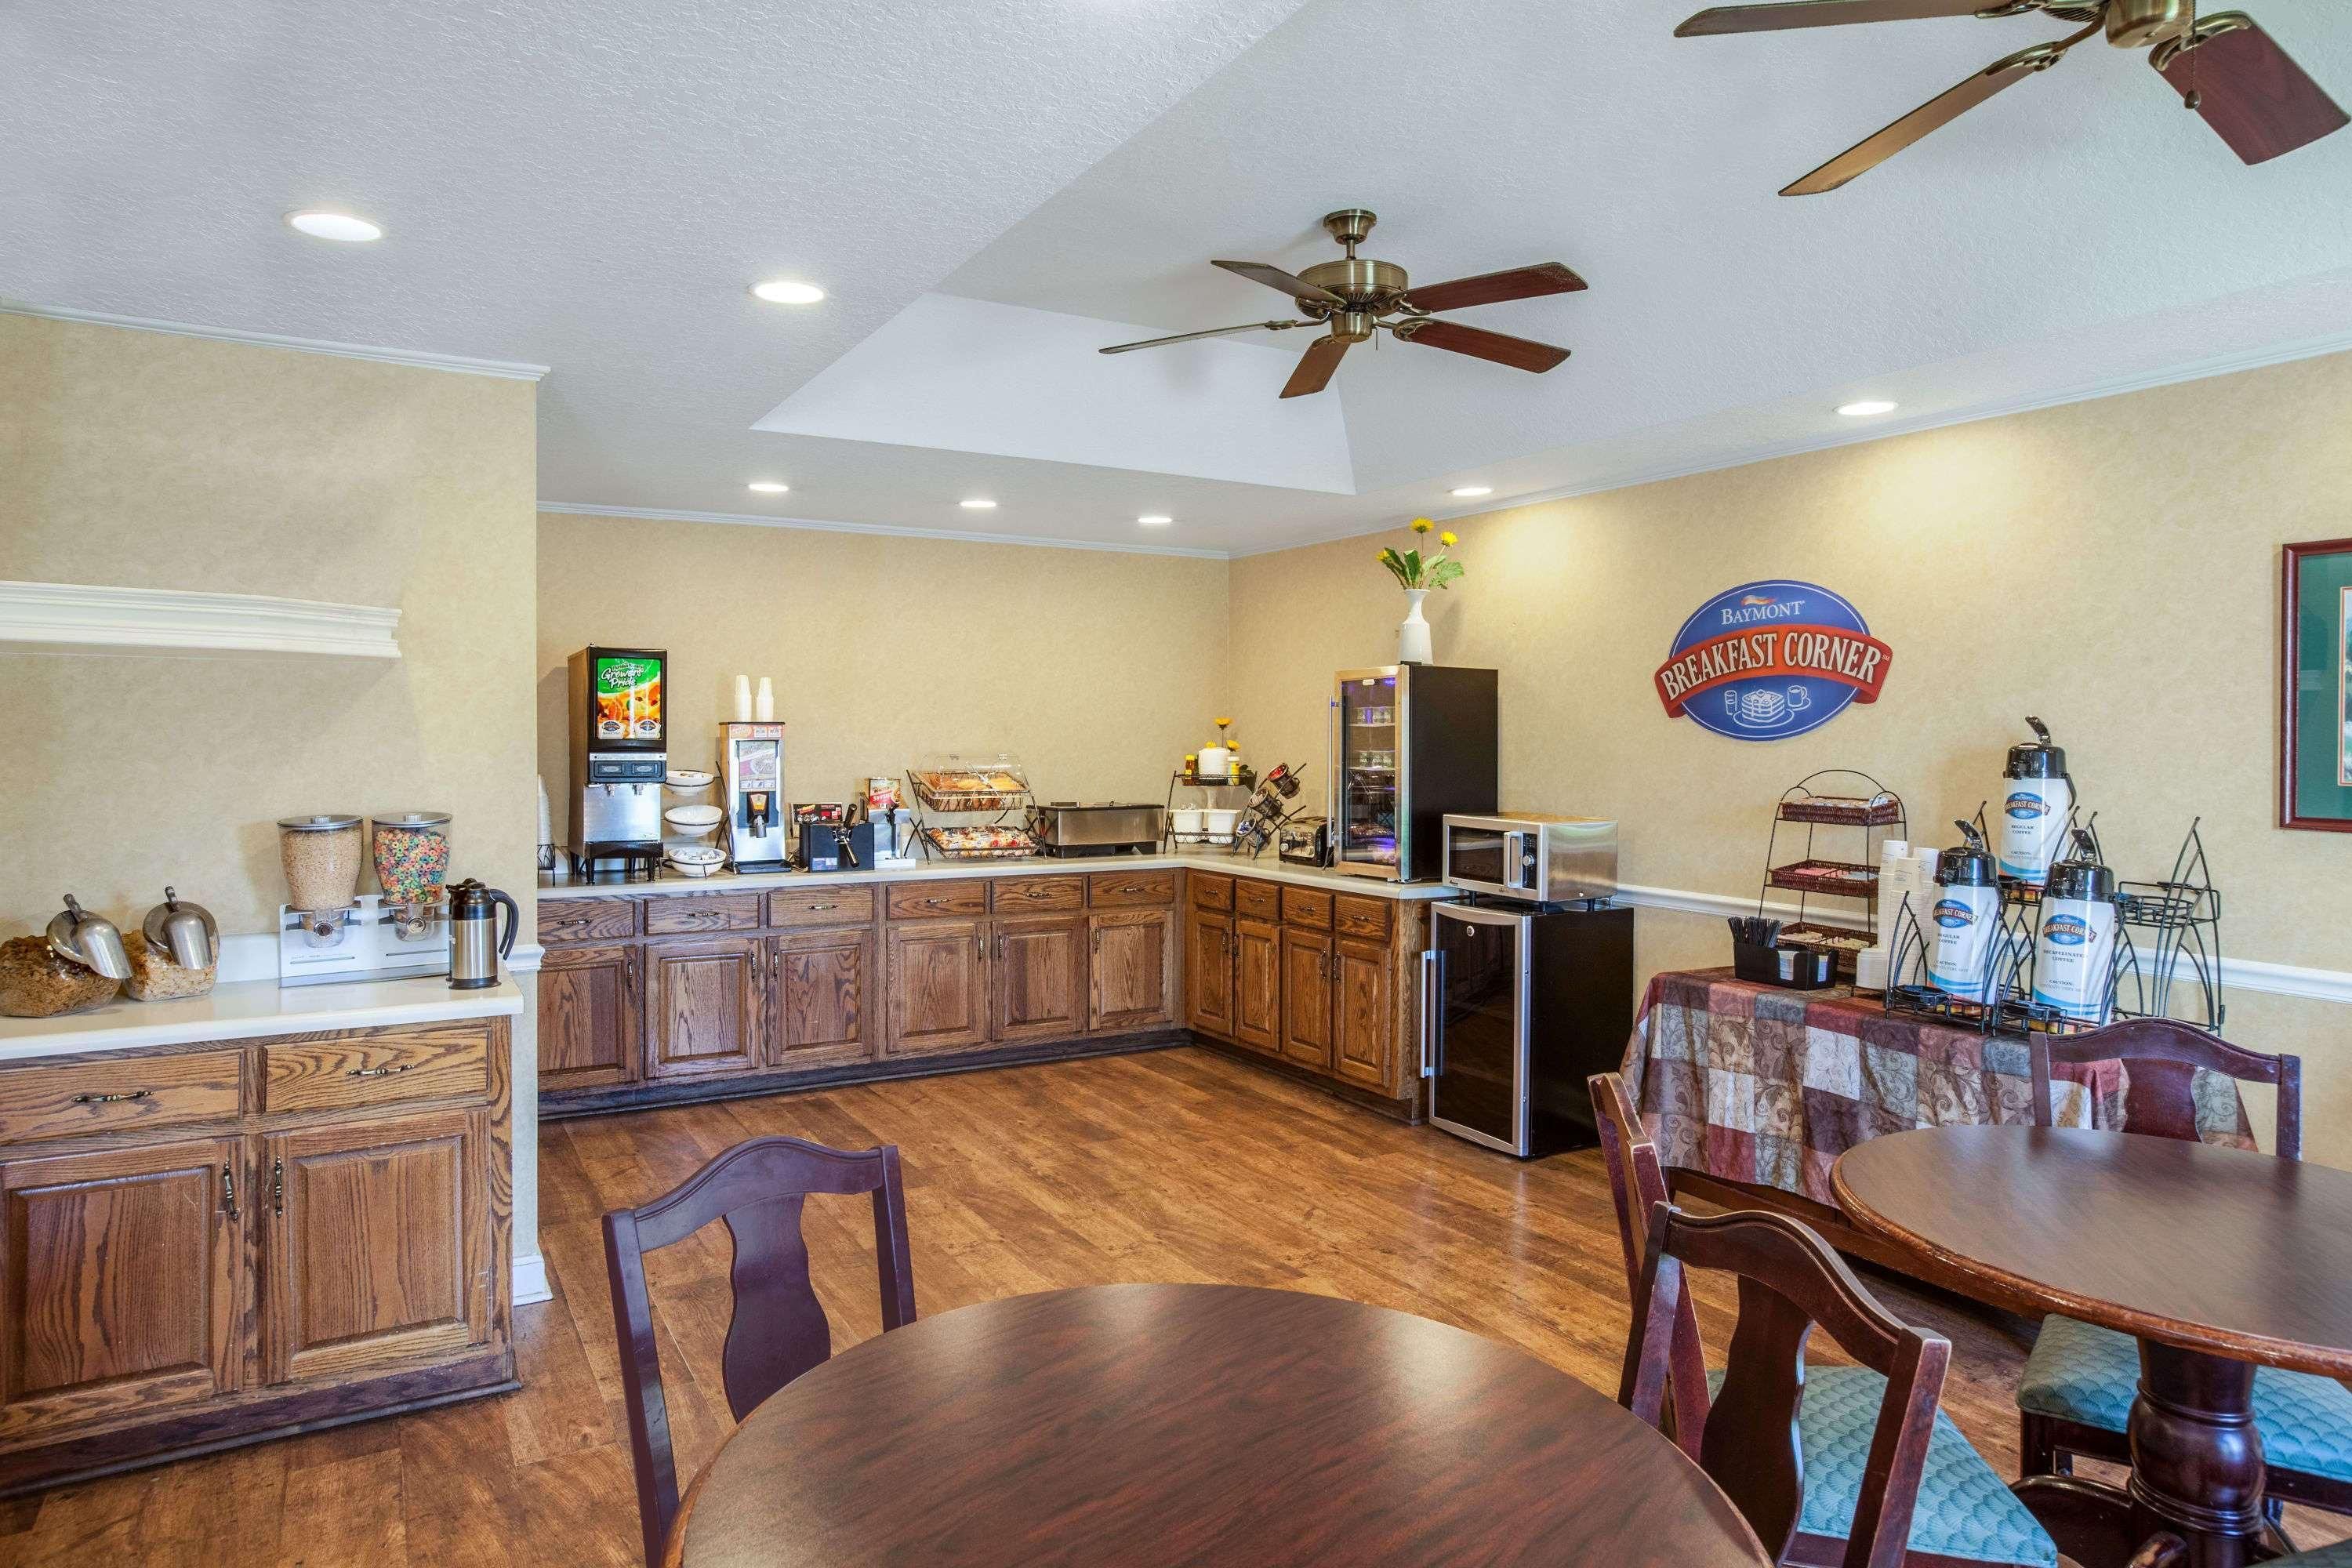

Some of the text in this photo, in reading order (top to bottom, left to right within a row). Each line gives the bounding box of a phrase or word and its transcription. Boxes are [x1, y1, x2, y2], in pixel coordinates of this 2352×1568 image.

[1721, 601, 1804, 625] BAYMONT
[1660, 633, 1777, 700] BREAKFAST
[1784, 632, 1882, 684] CORNER
[609, 677, 636, 689] Pride
[2043, 924, 2096, 941] BREAKFAST CORER
